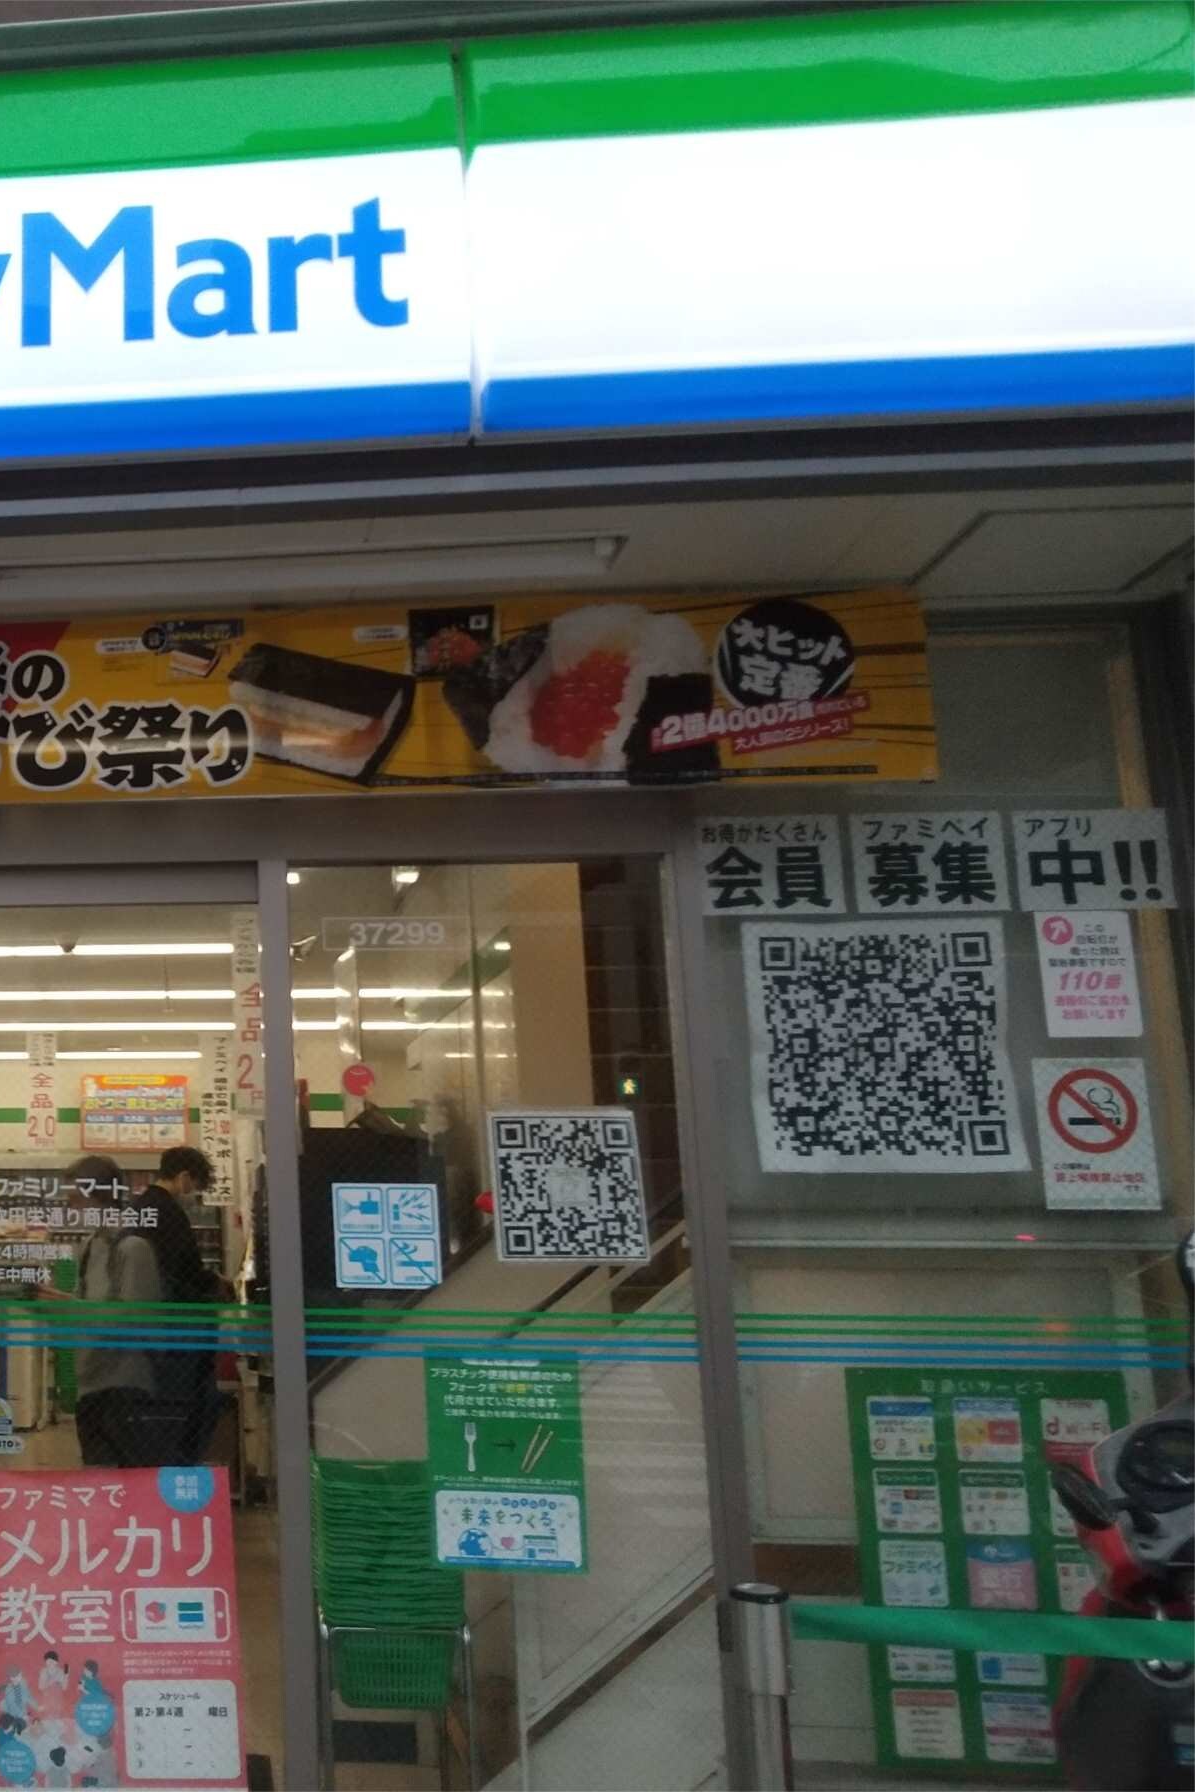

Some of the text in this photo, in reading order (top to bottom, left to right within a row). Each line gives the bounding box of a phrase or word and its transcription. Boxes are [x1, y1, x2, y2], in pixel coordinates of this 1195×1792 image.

[732, 619, 846, 665] 大ヒット
[738, 654, 822, 700] 定番
[702, 818, 1091, 843] お得がたくさん ファミペイ アプリ
[706, 839, 1160, 908] 会員 募集 中!!
[350, 922, 446, 946] 37299
[1059, 971, 1122, 990] 110番
[462, 1508, 552, 1528] 未来をつくる
